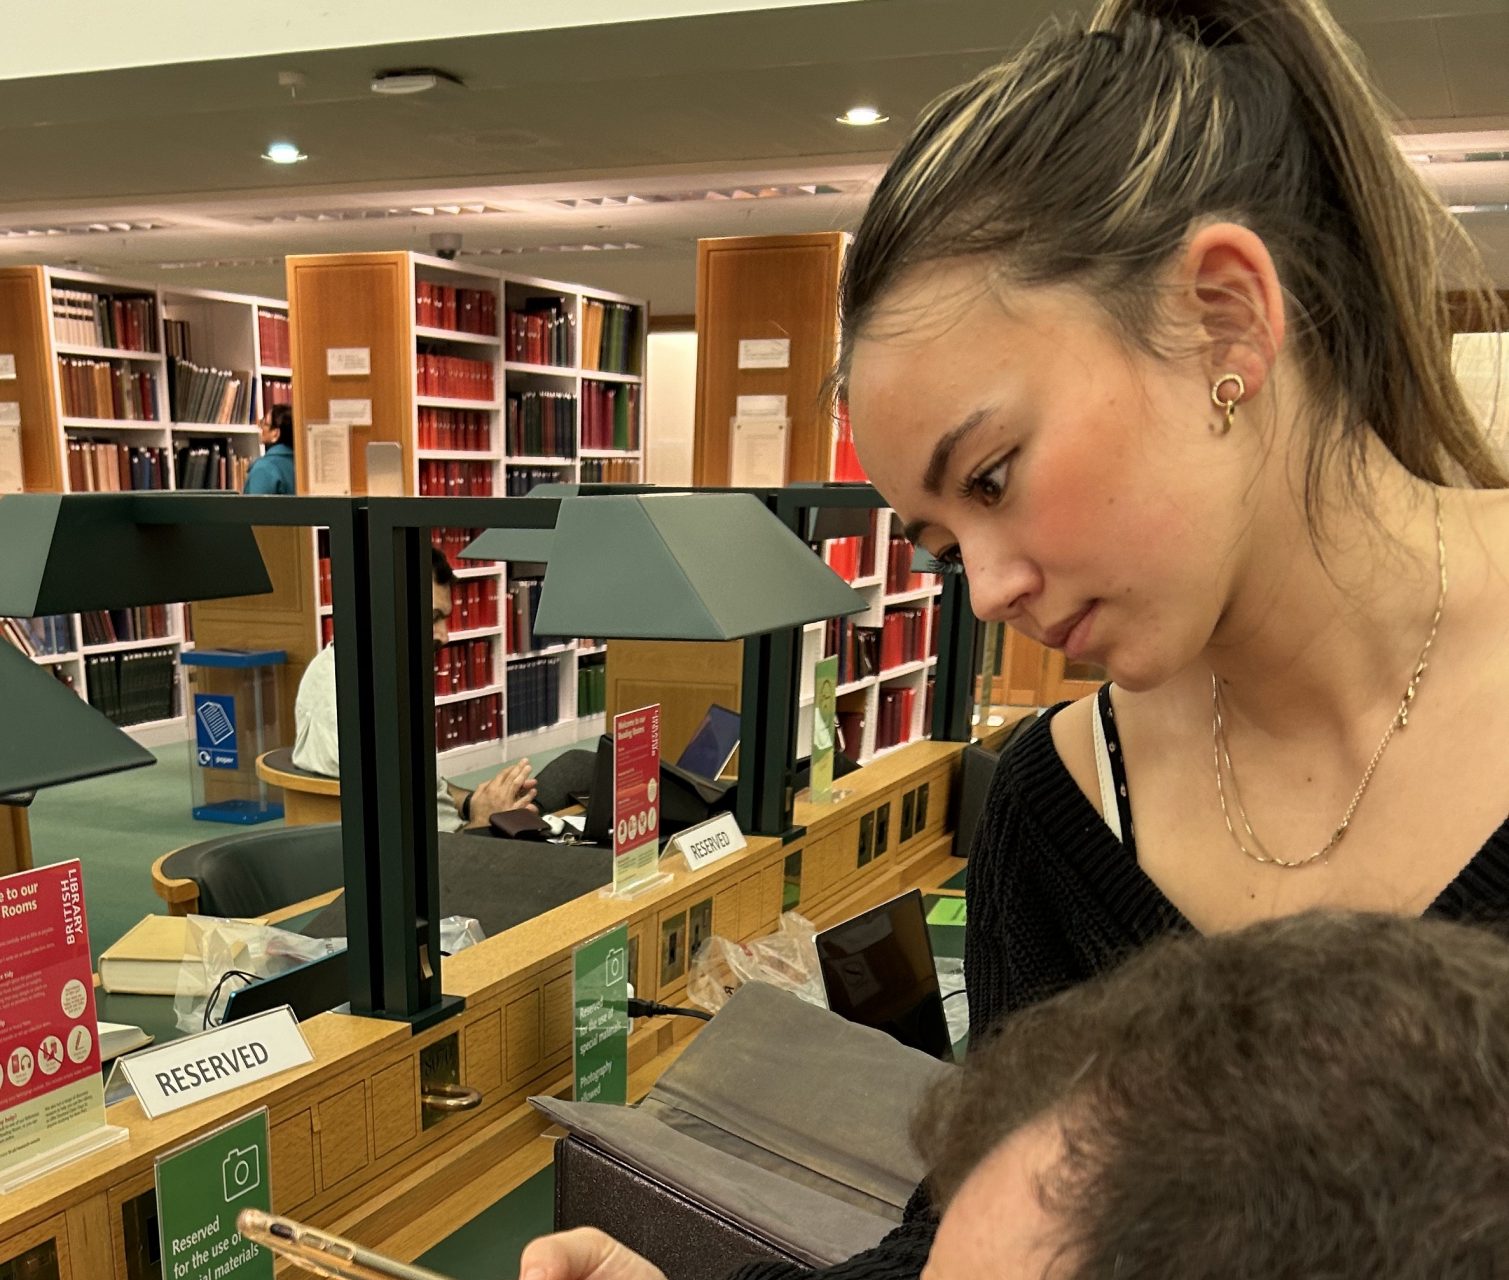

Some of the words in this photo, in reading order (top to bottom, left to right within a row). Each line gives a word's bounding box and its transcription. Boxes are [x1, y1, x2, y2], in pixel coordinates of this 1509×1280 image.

[690, 832, 730, 860] RESERVED
[6, 888, 18, 900] to
[21, 883, 38, 897] our
[68, 868, 83, 934] LIBRARY
[2, 900, 38, 919] Rooms
[61, 880, 75, 945] BRITISH
[580, 994, 604, 1020] Reserved
[580, 1032, 598, 1056] special
[154, 1041, 270, 1097] RESERVED
[580, 1060, 613, 1088] Photography
[172, 1215, 220, 1256] Reserved
[174, 1262, 189, 1280] for
[192, 1252, 209, 1269] the
[212, 1241, 229, 1258] use
[214, 1242, 259, 1280] materials
